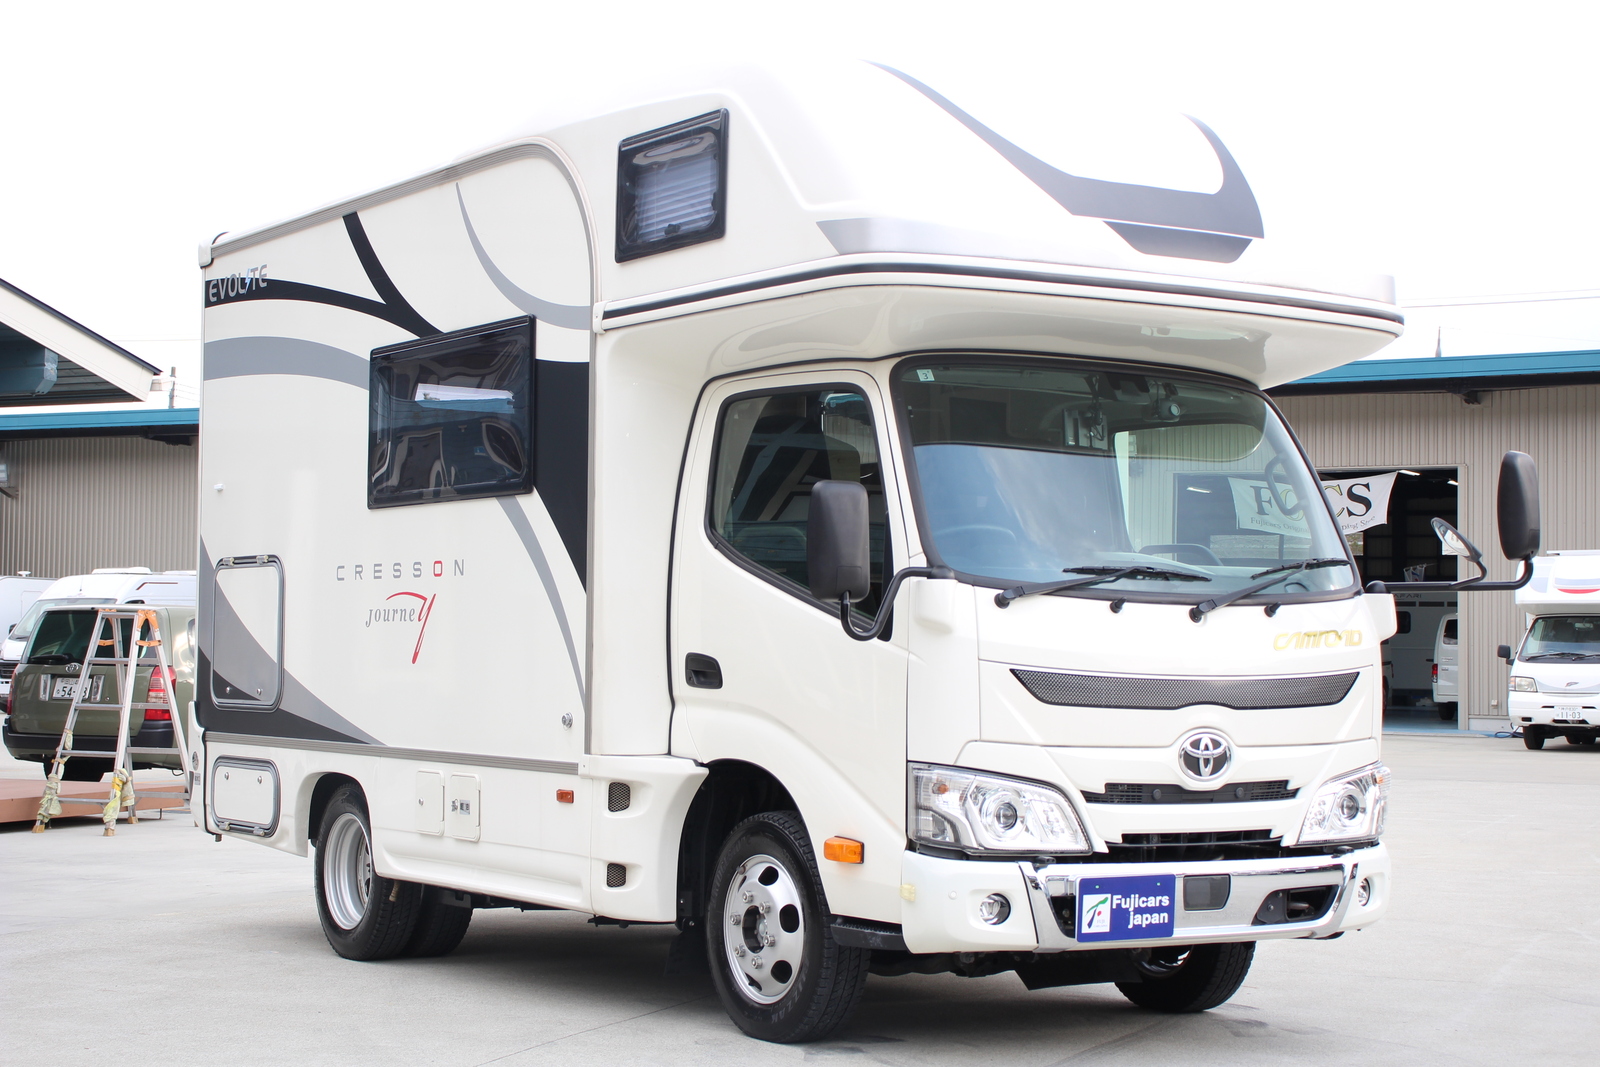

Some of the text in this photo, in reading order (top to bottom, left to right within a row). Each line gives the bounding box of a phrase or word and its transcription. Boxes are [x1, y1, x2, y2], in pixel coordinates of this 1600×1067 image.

[336, 559, 465, 581] CRESSON
[1112, 894, 1170, 911] Fujicars
[1127, 911, 1169, 929] japan
